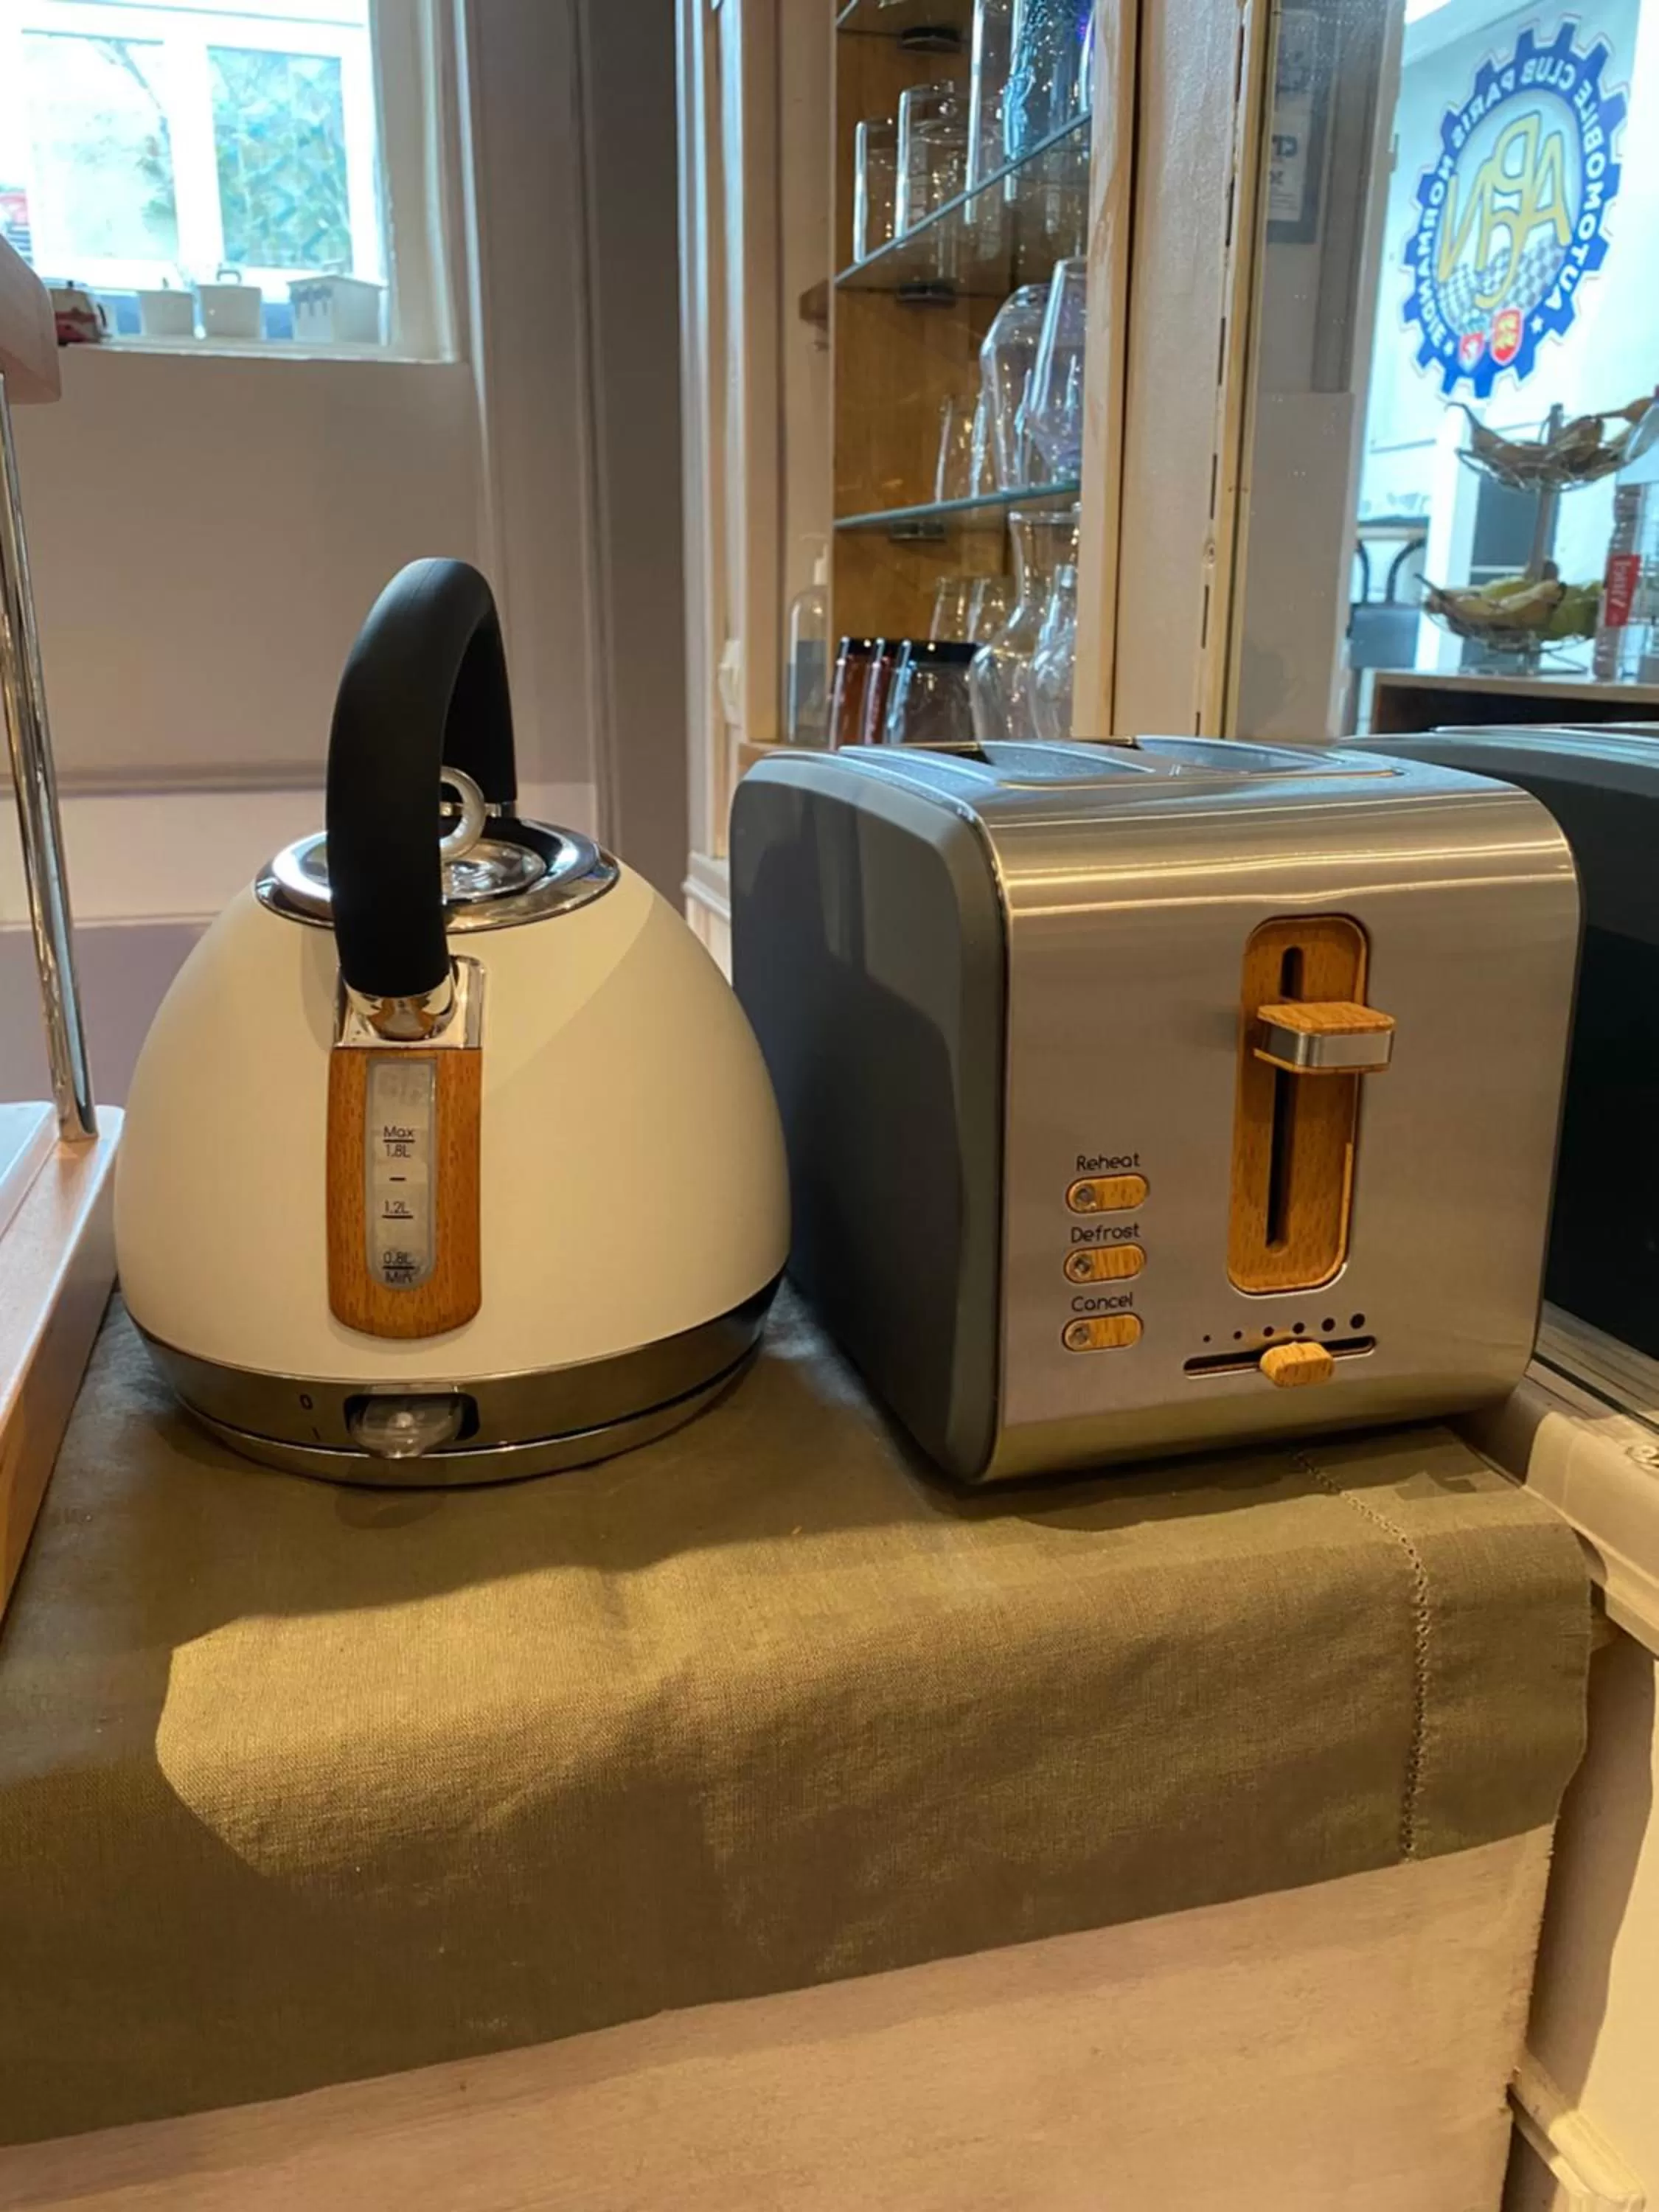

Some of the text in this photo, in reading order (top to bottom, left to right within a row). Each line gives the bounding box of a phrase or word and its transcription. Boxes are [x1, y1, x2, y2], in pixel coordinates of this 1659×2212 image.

[383, 1125, 415, 1138] Max
[386, 1144, 411, 1158] 1.8L
[1076, 1152, 1141, 1172] Reheat
[384, 1200, 410, 1214] 1.2L
[1071, 1222, 1141, 1244] Defrost
[1071, 1291, 1133, 1312] Cancel
